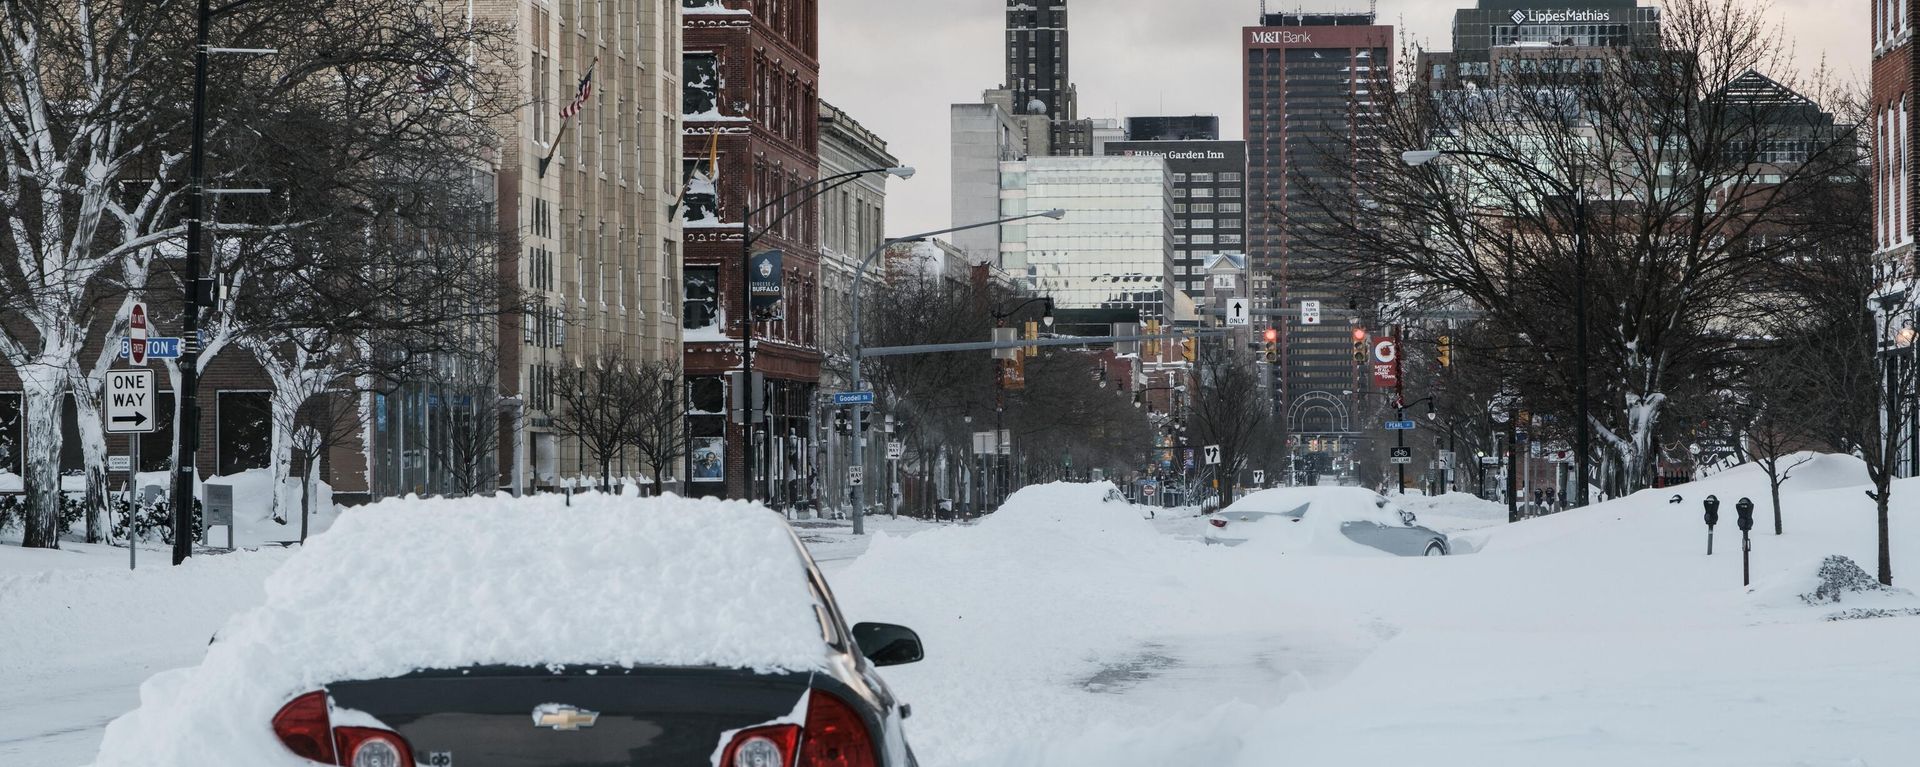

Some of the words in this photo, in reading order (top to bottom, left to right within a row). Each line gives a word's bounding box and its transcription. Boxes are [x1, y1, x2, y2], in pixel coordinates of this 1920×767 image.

[1252, 31, 1281, 43] M&T
[1283, 31, 1311, 43] Bank
[1135, 150, 1167, 159] Hilton
[1169, 150, 1204, 159] Garden
[1207, 150, 1224, 159] Inn
[122, 341, 169, 354] BTON
[133, 343, 143, 353] ENTER
[114, 375, 145, 389] ONE
[113, 393, 145, 407] WAY
